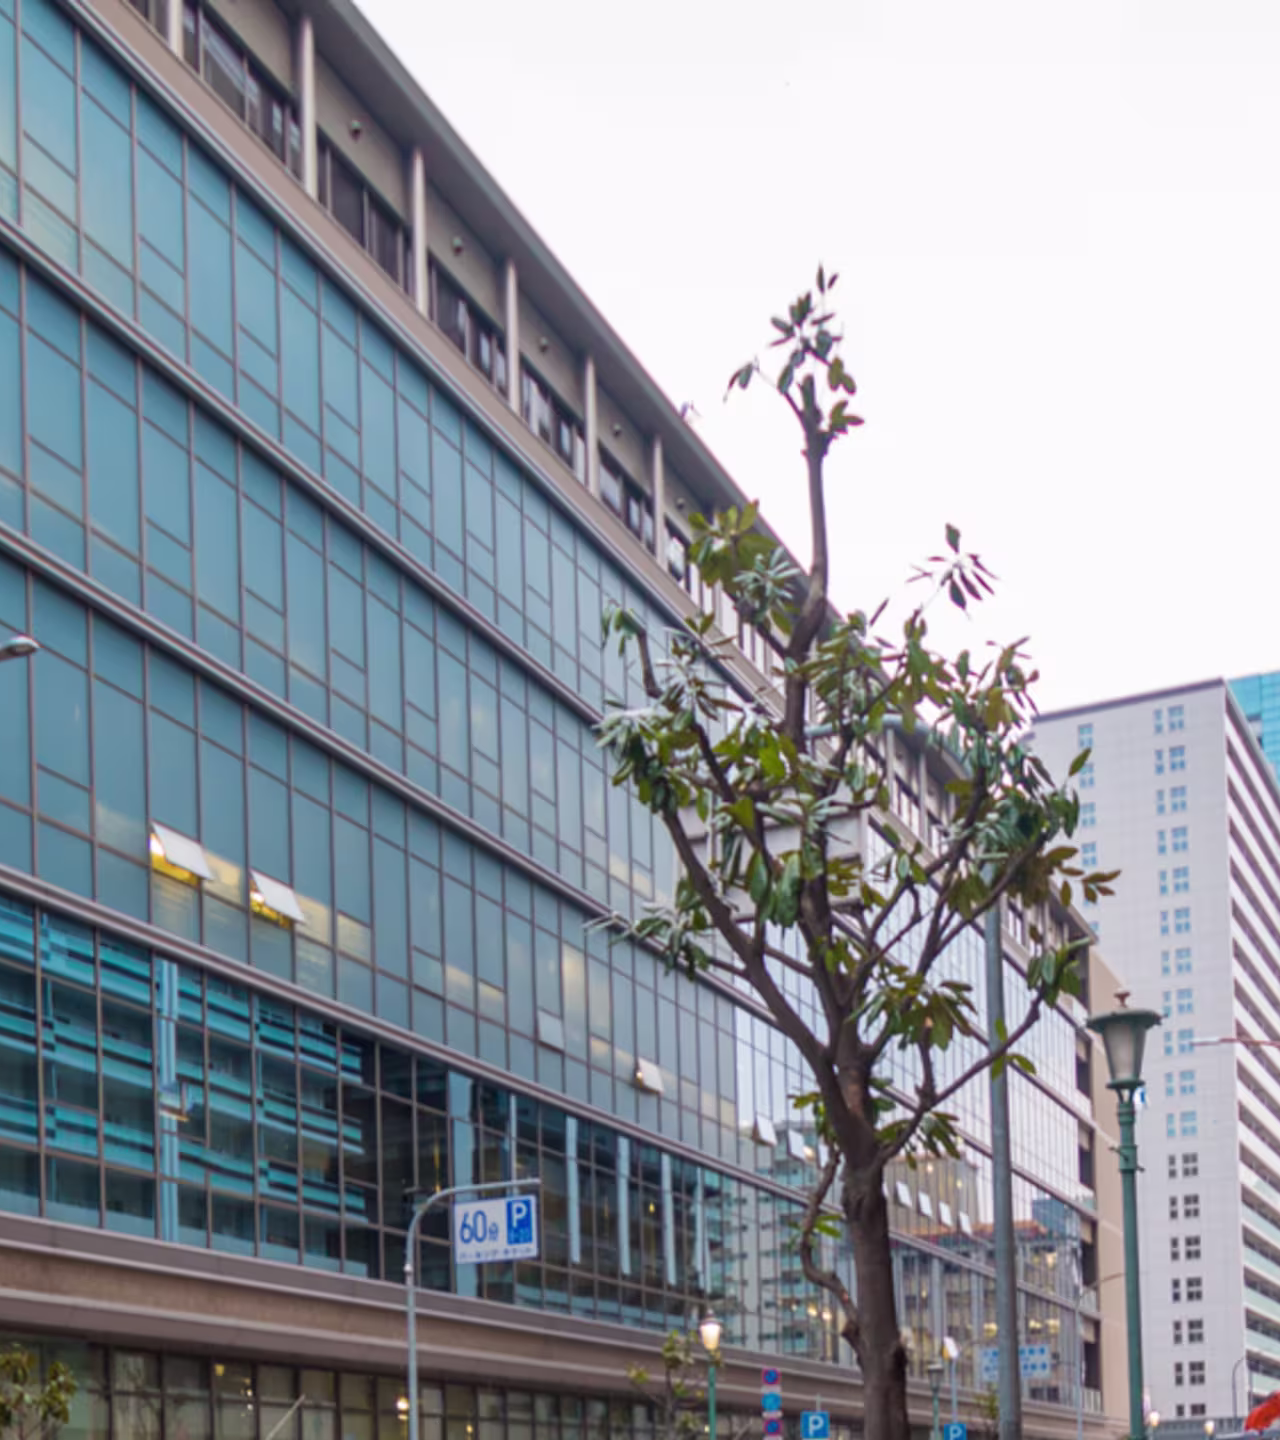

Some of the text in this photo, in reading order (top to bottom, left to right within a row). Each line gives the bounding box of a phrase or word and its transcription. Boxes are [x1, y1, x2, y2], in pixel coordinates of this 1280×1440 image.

[512, 1203, 527, 1229] P
[809, 1415, 824, 1437] P
[950, 1426, 962, 1440] P
